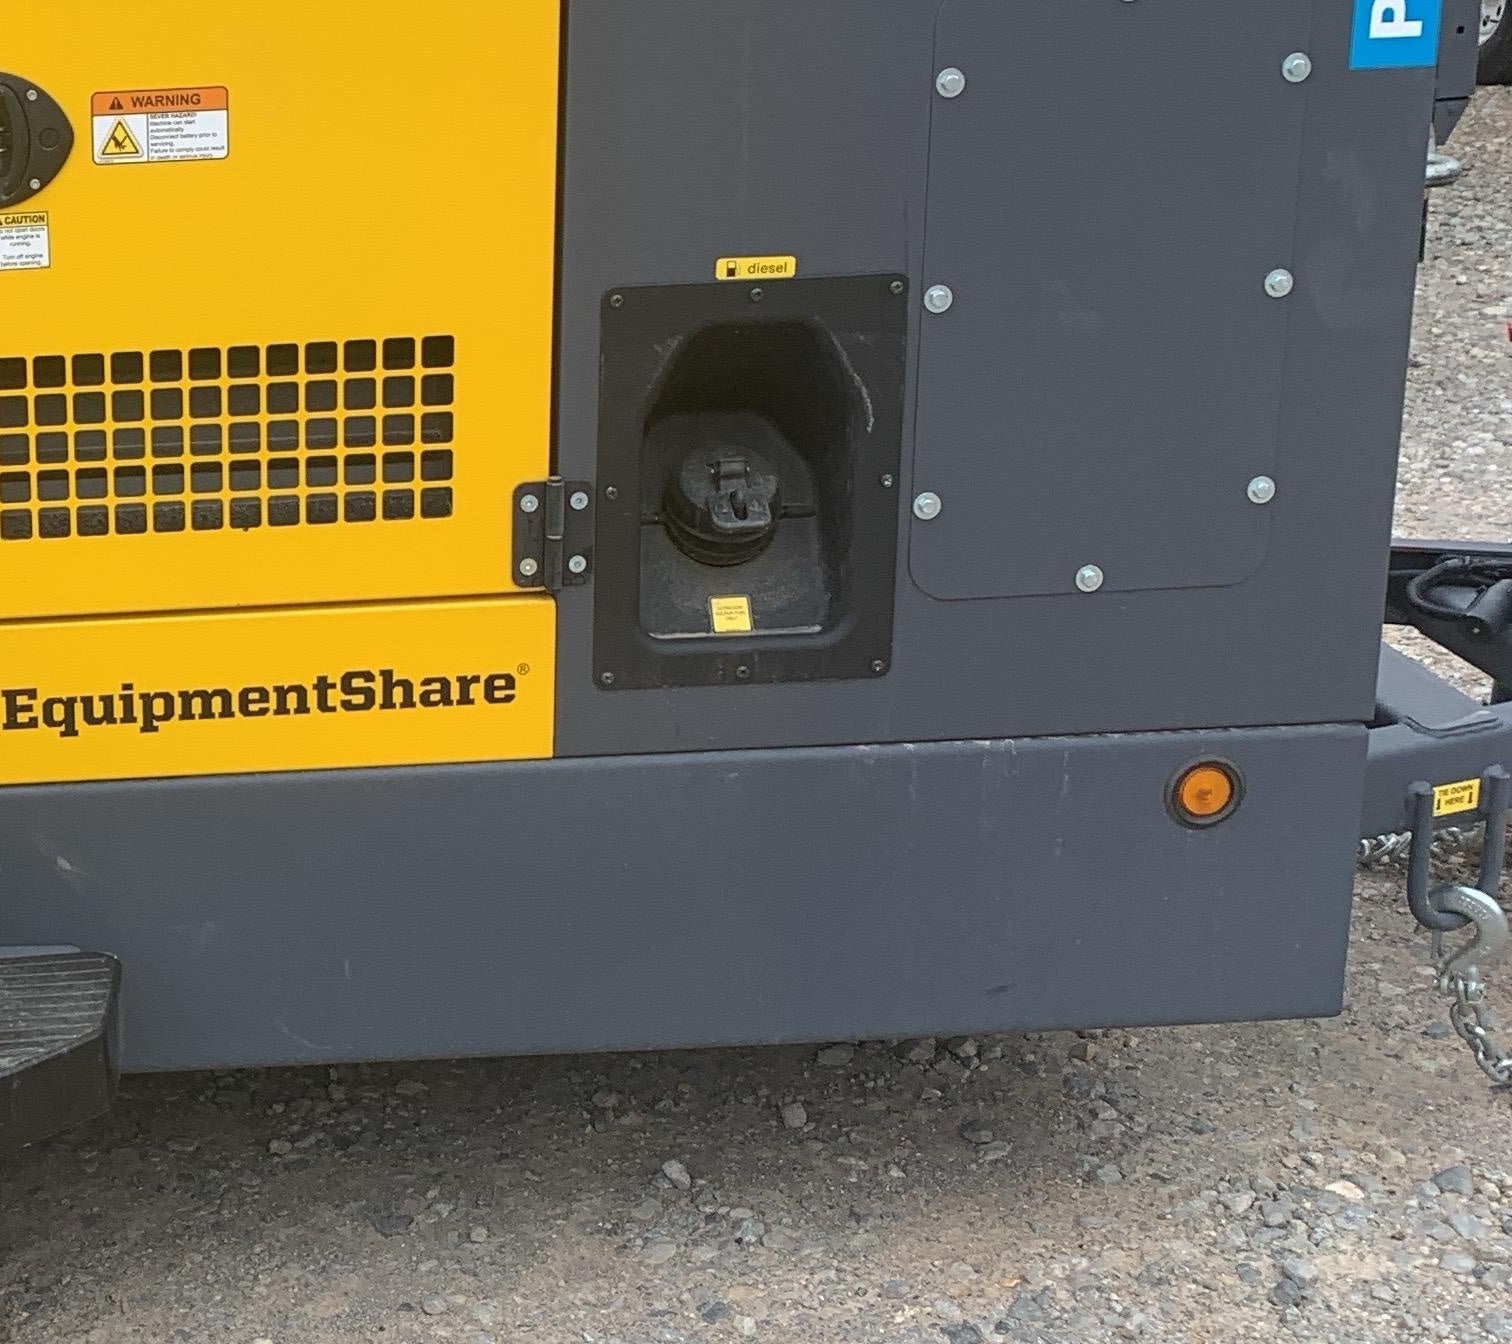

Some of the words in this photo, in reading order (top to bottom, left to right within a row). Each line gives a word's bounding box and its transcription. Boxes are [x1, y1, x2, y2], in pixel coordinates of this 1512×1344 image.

[131, 93, 201, 108] WARNING
[4, 214, 45, 225] CAUTION
[747, 261, 787, 274] diesel
